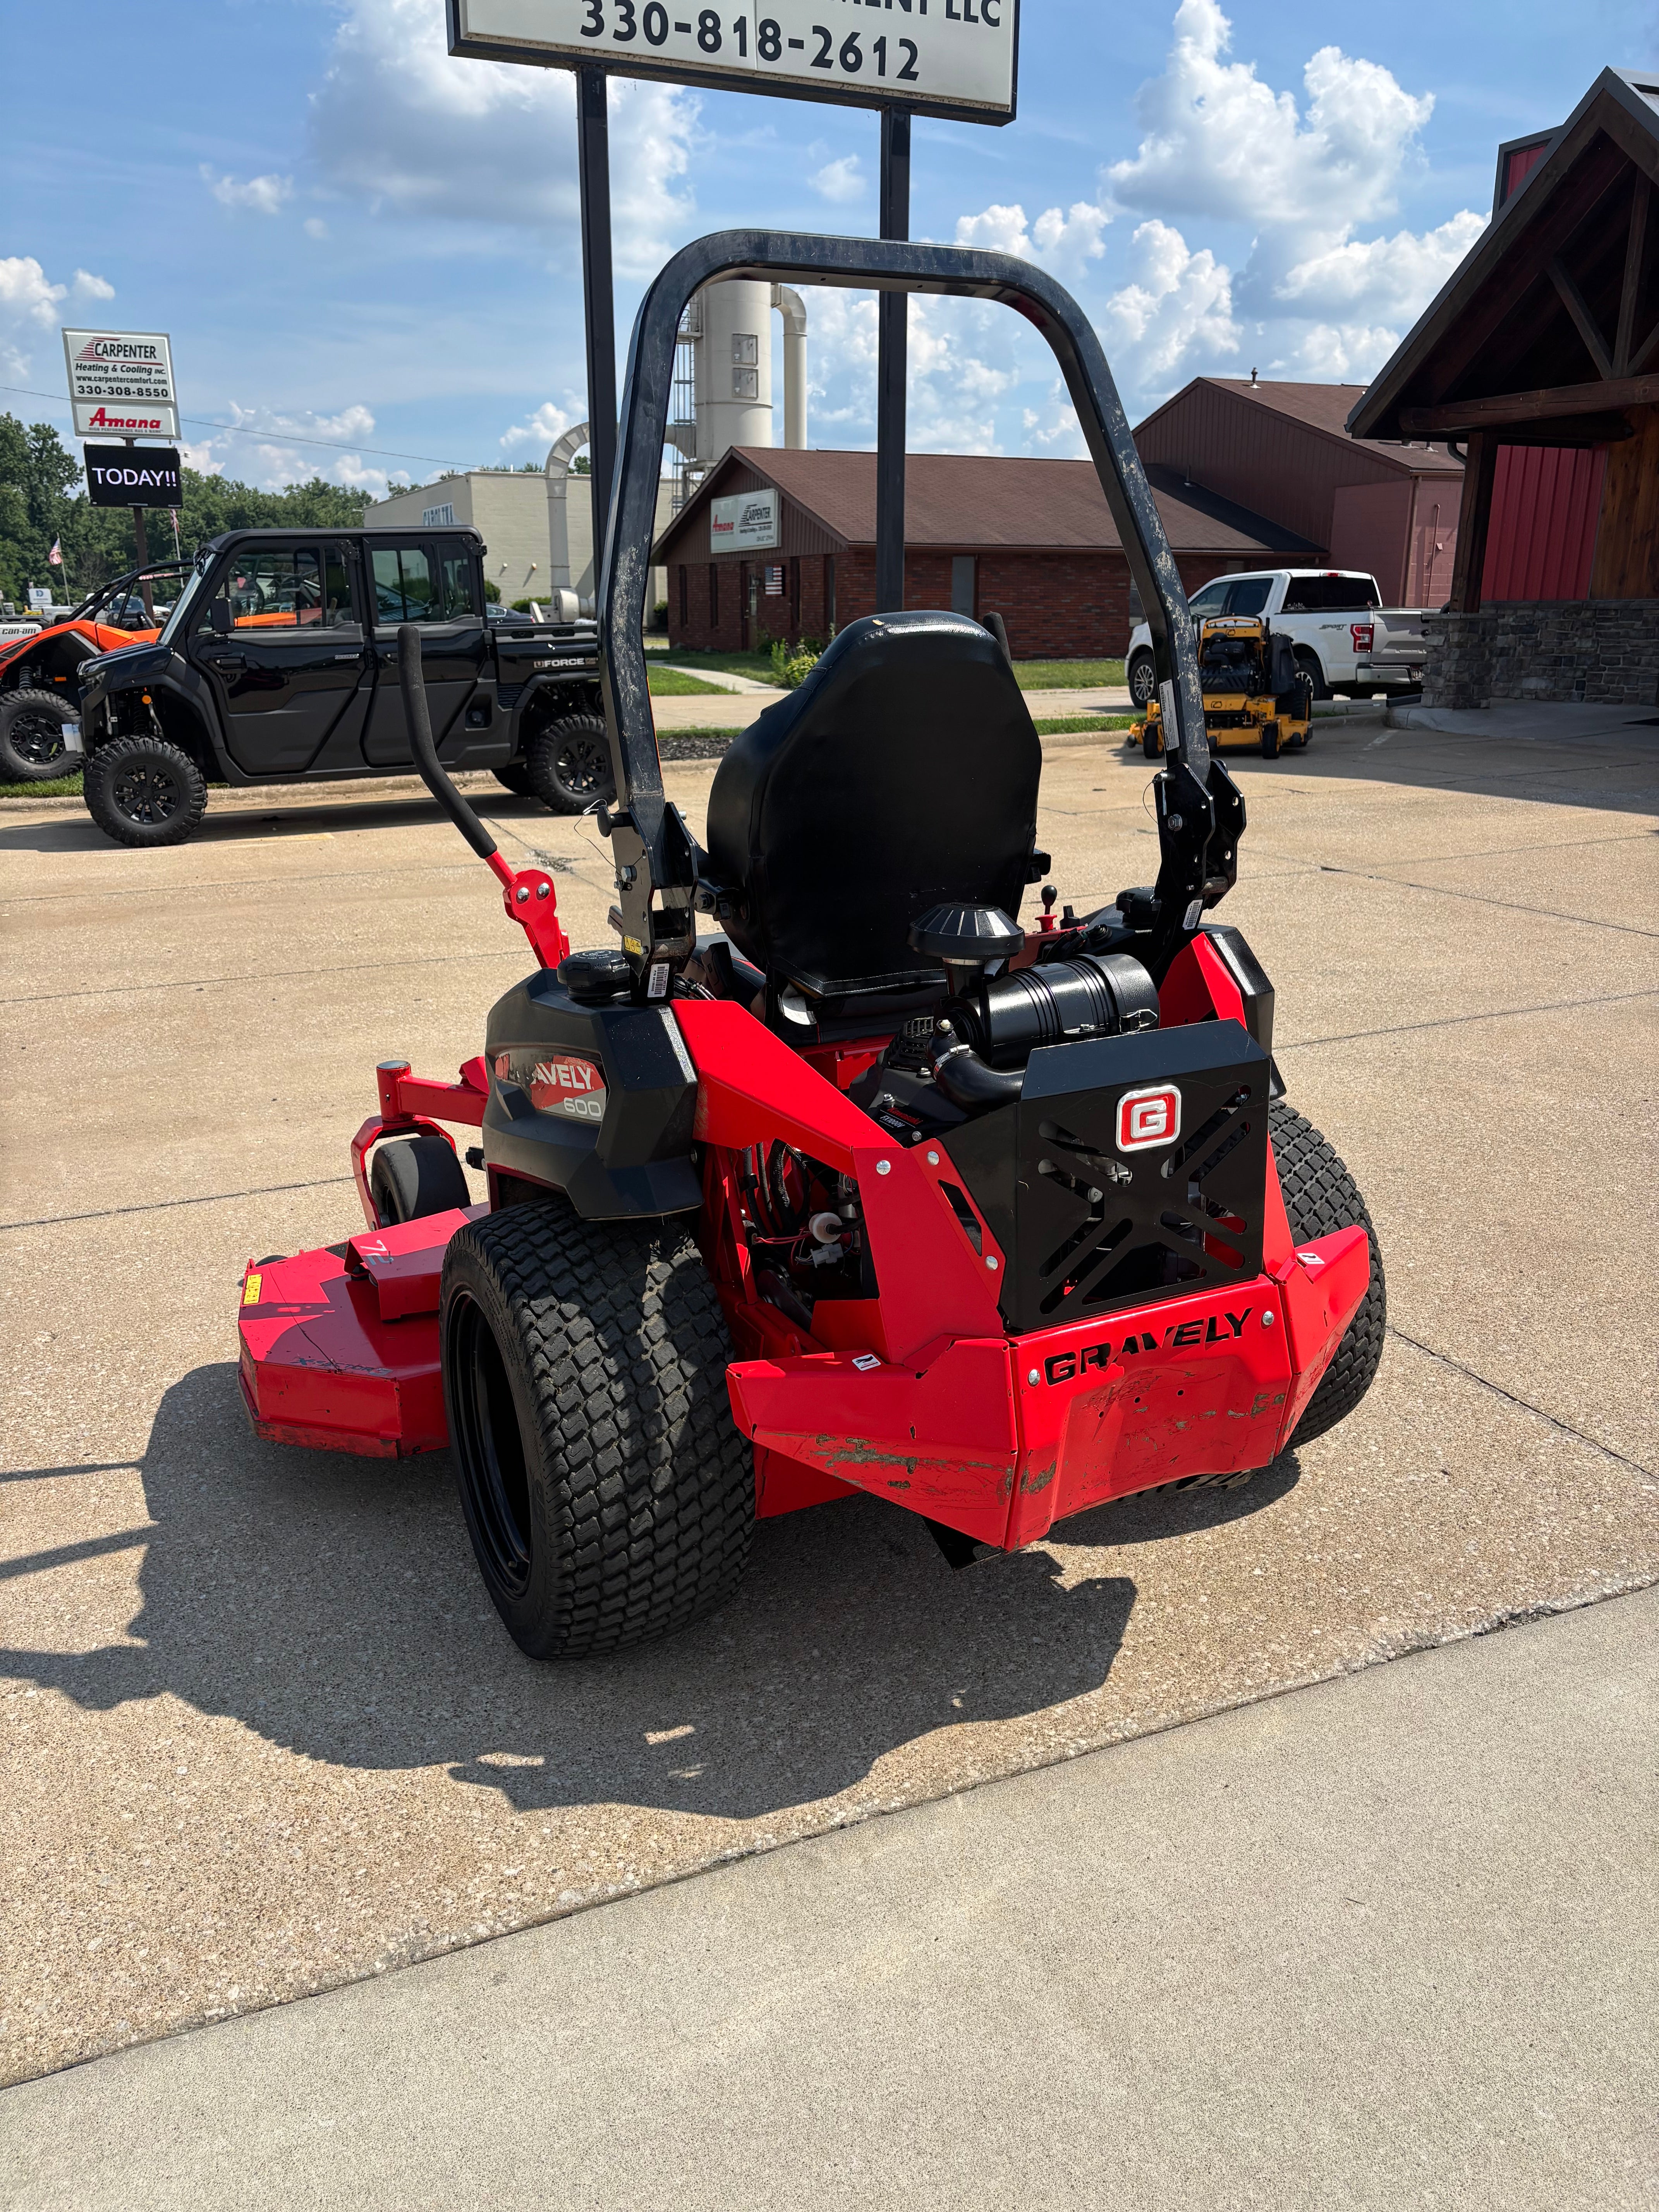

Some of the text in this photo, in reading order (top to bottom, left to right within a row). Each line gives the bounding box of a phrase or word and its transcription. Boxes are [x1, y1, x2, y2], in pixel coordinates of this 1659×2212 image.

[945, 0, 1000, 27] LLC
[580, 0, 919, 81] 330-818-2612
[95, 343, 156, 359] CARPENTER
[76, 363, 109, 374] Heating
[120, 365, 153, 376] Cooling
[76, 375, 168, 385] www.carpentercomfort.com
[89, 407, 161, 429] Amana
[91, 467, 177, 487] TODAY!!
[563, 1097, 601, 1117] 600
[879, 1115, 906, 1128] FX1000V
[1130, 1099, 1168, 1139] G
[1044, 1307, 1254, 1386] GRAVELY
